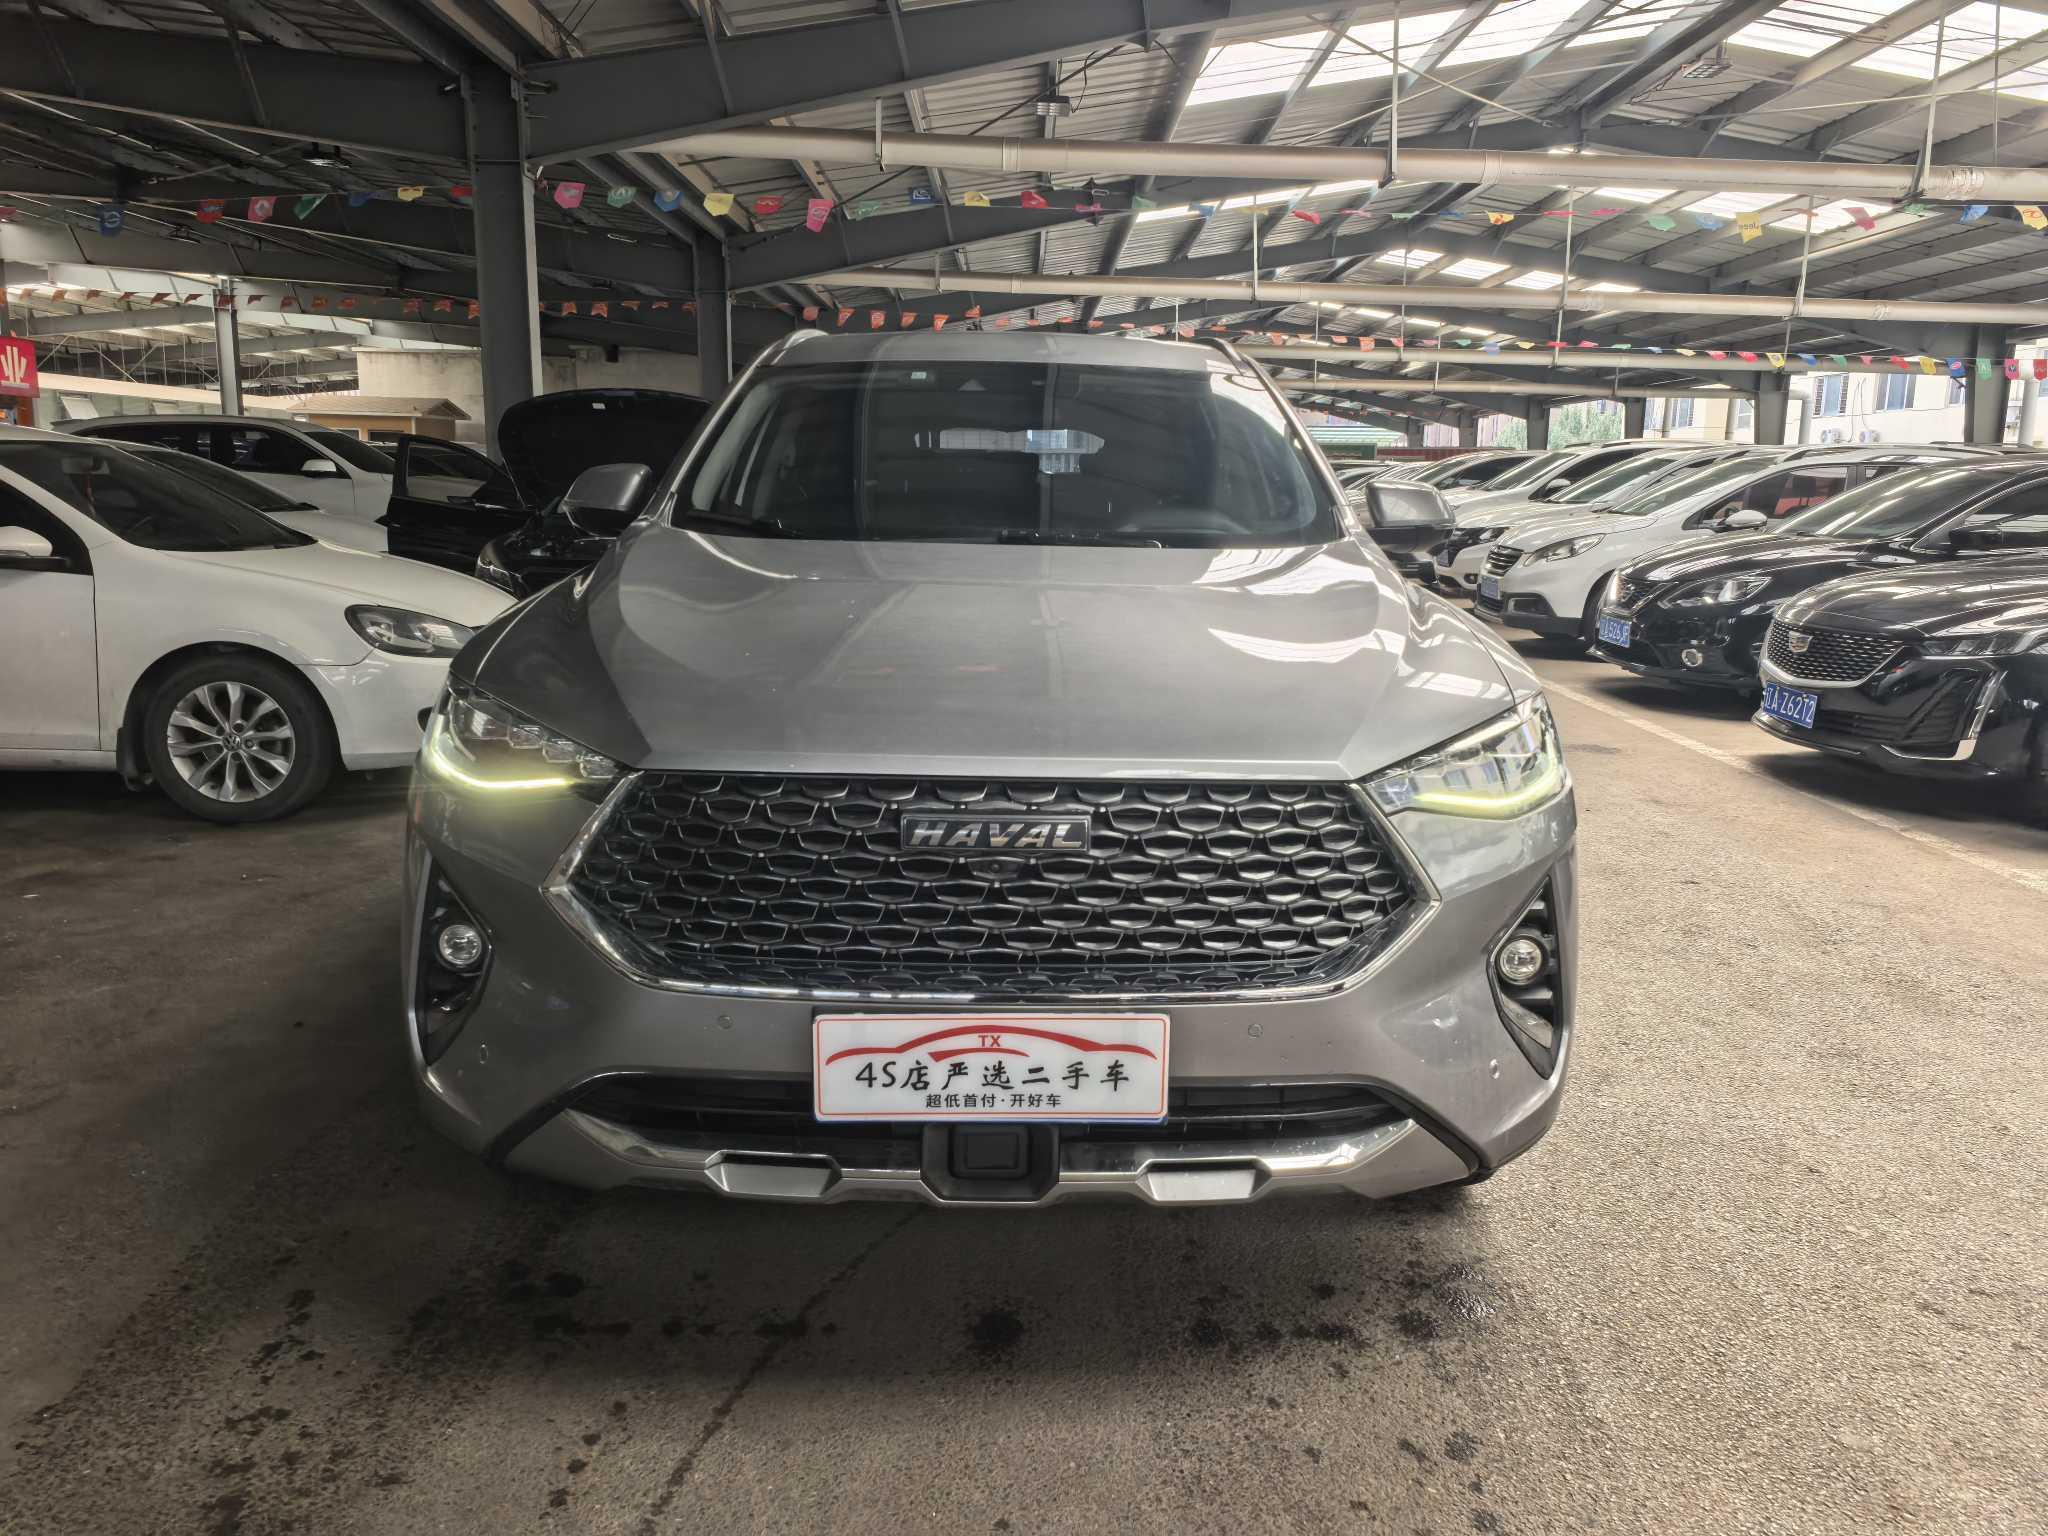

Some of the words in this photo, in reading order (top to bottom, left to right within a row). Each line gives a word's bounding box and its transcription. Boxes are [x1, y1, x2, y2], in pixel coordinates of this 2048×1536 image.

[909, 822, 1082, 848] HAVAL
[978, 1035, 1001, 1048] TX
[855, 1060, 1130, 1092] 4S店严选二手车
